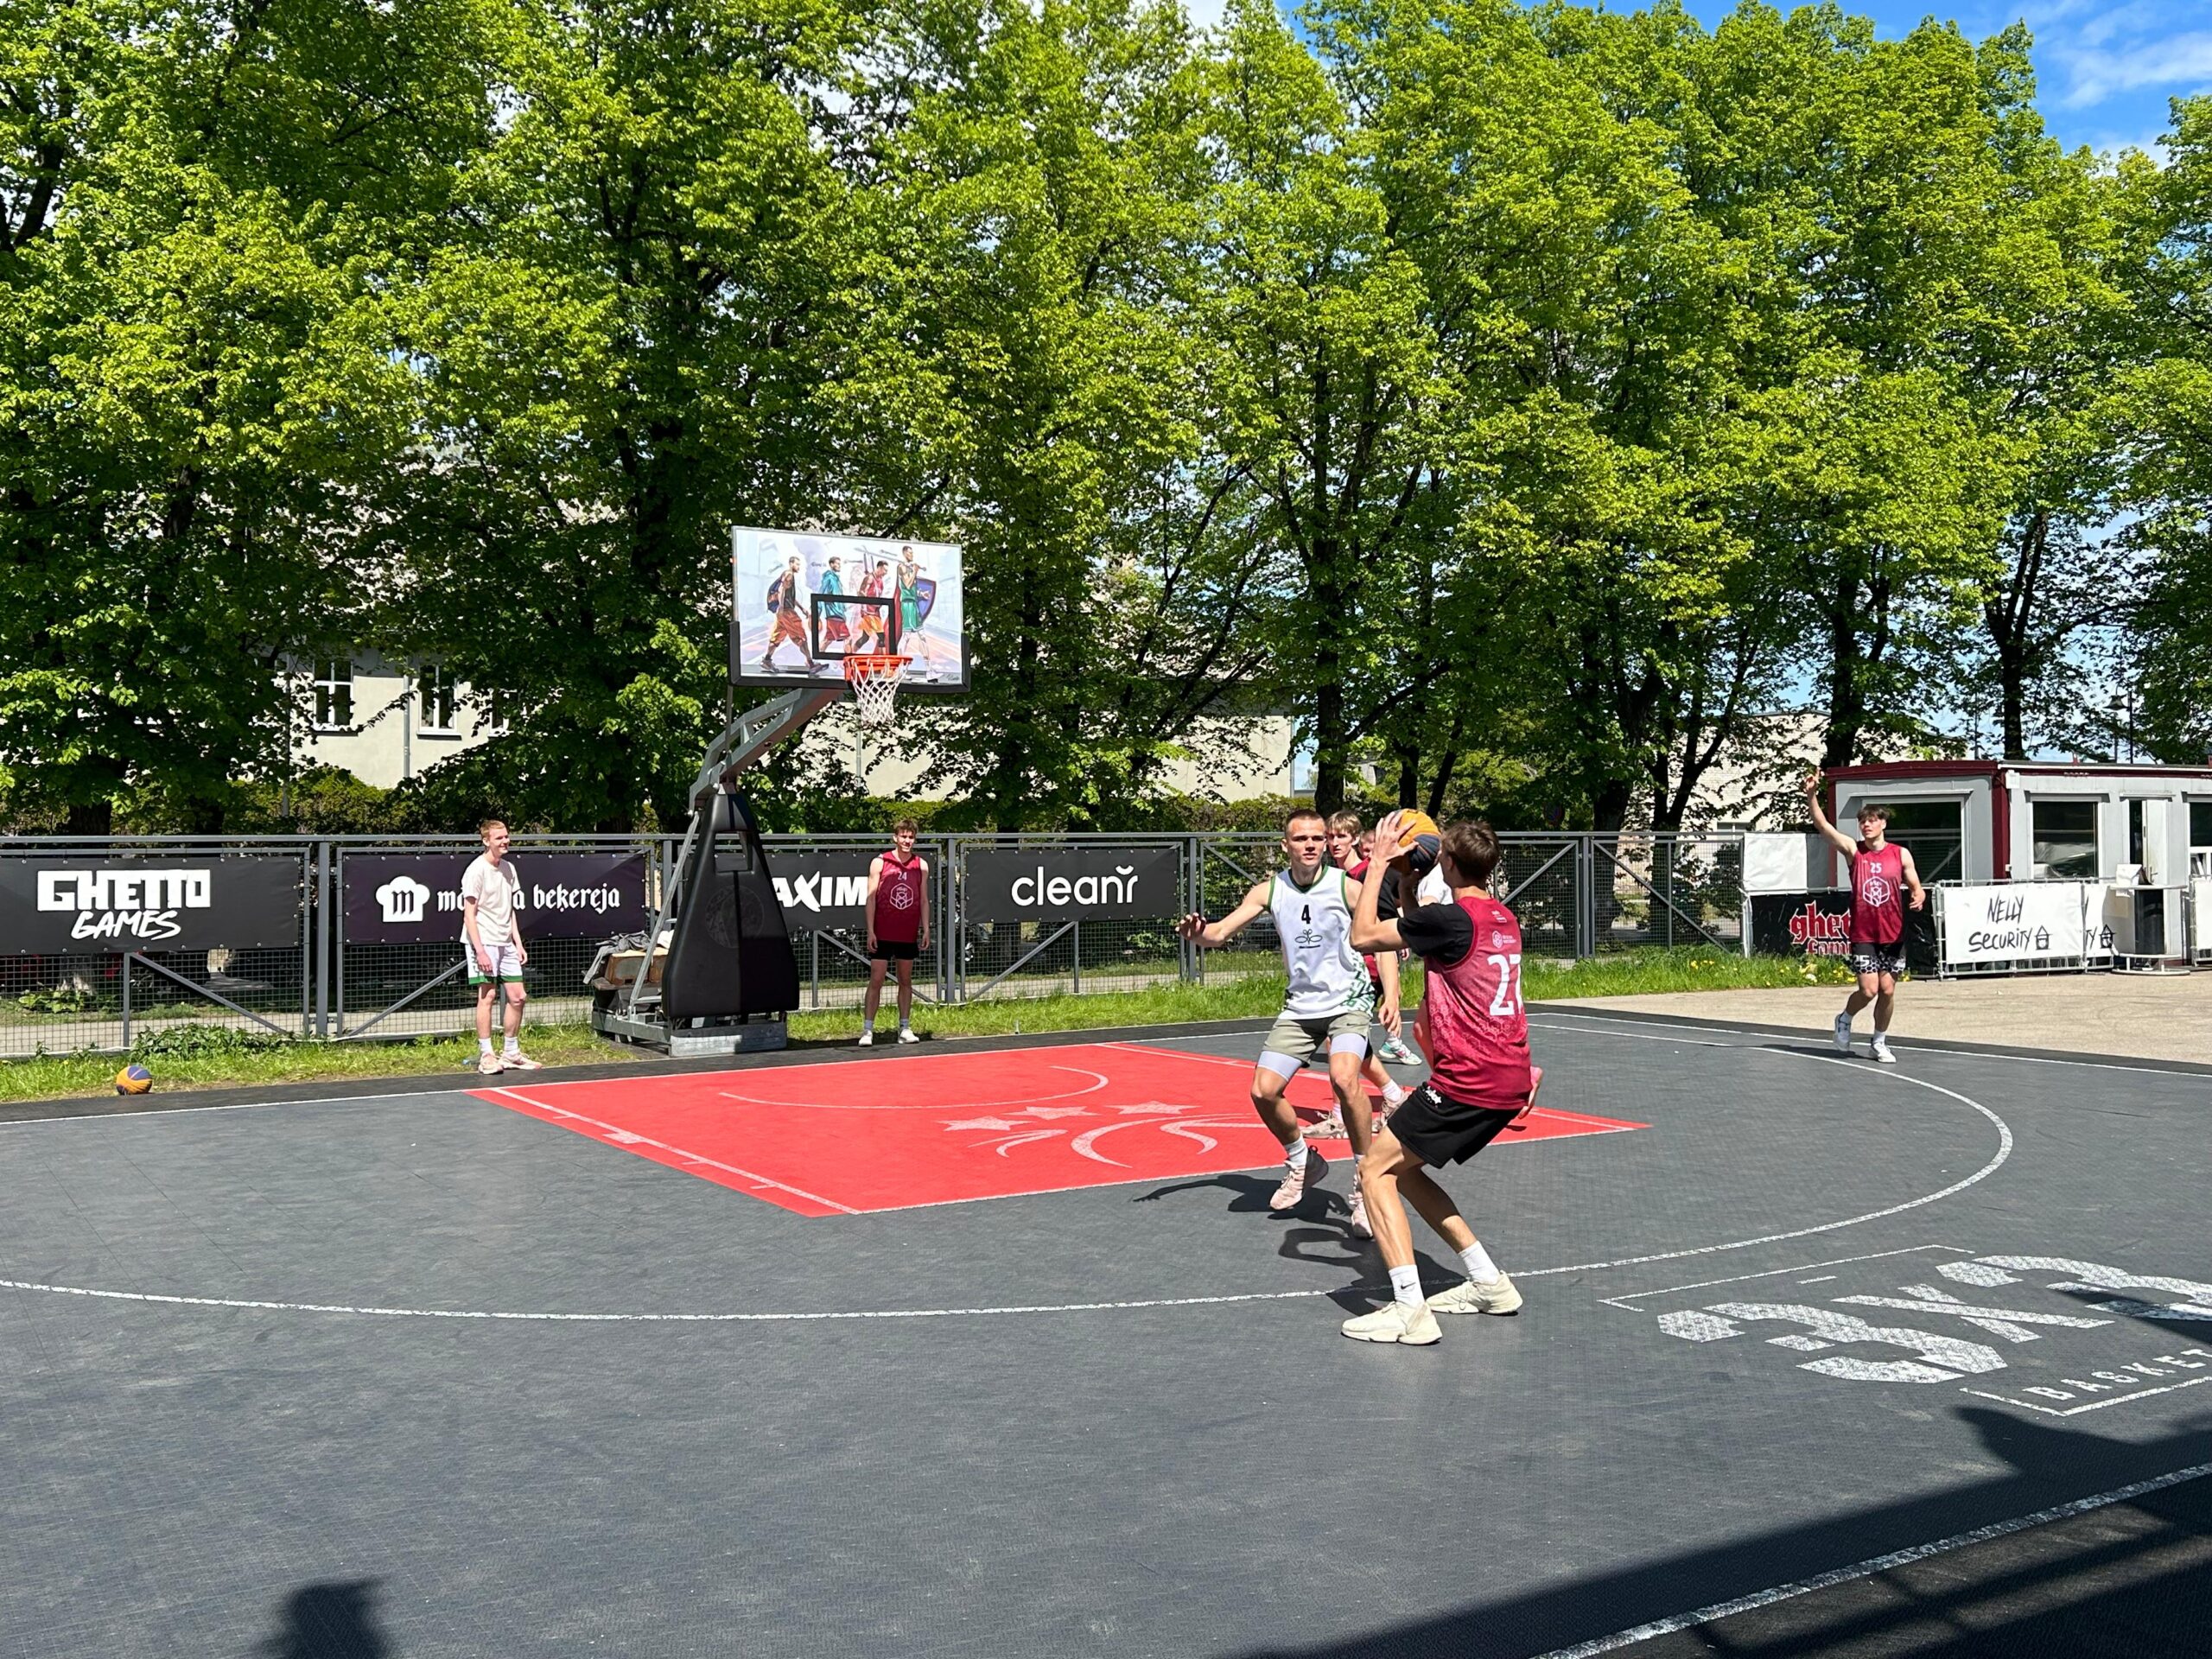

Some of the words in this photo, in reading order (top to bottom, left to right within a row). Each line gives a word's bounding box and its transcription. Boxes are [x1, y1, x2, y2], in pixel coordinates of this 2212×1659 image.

[1870, 862, 1882, 874] 25
[37, 869, 211, 911] GHETTO
[1301, 904, 1312, 925] 4
[1986, 893, 2024, 924] NELLY
[71, 910, 181, 940] GAMES
